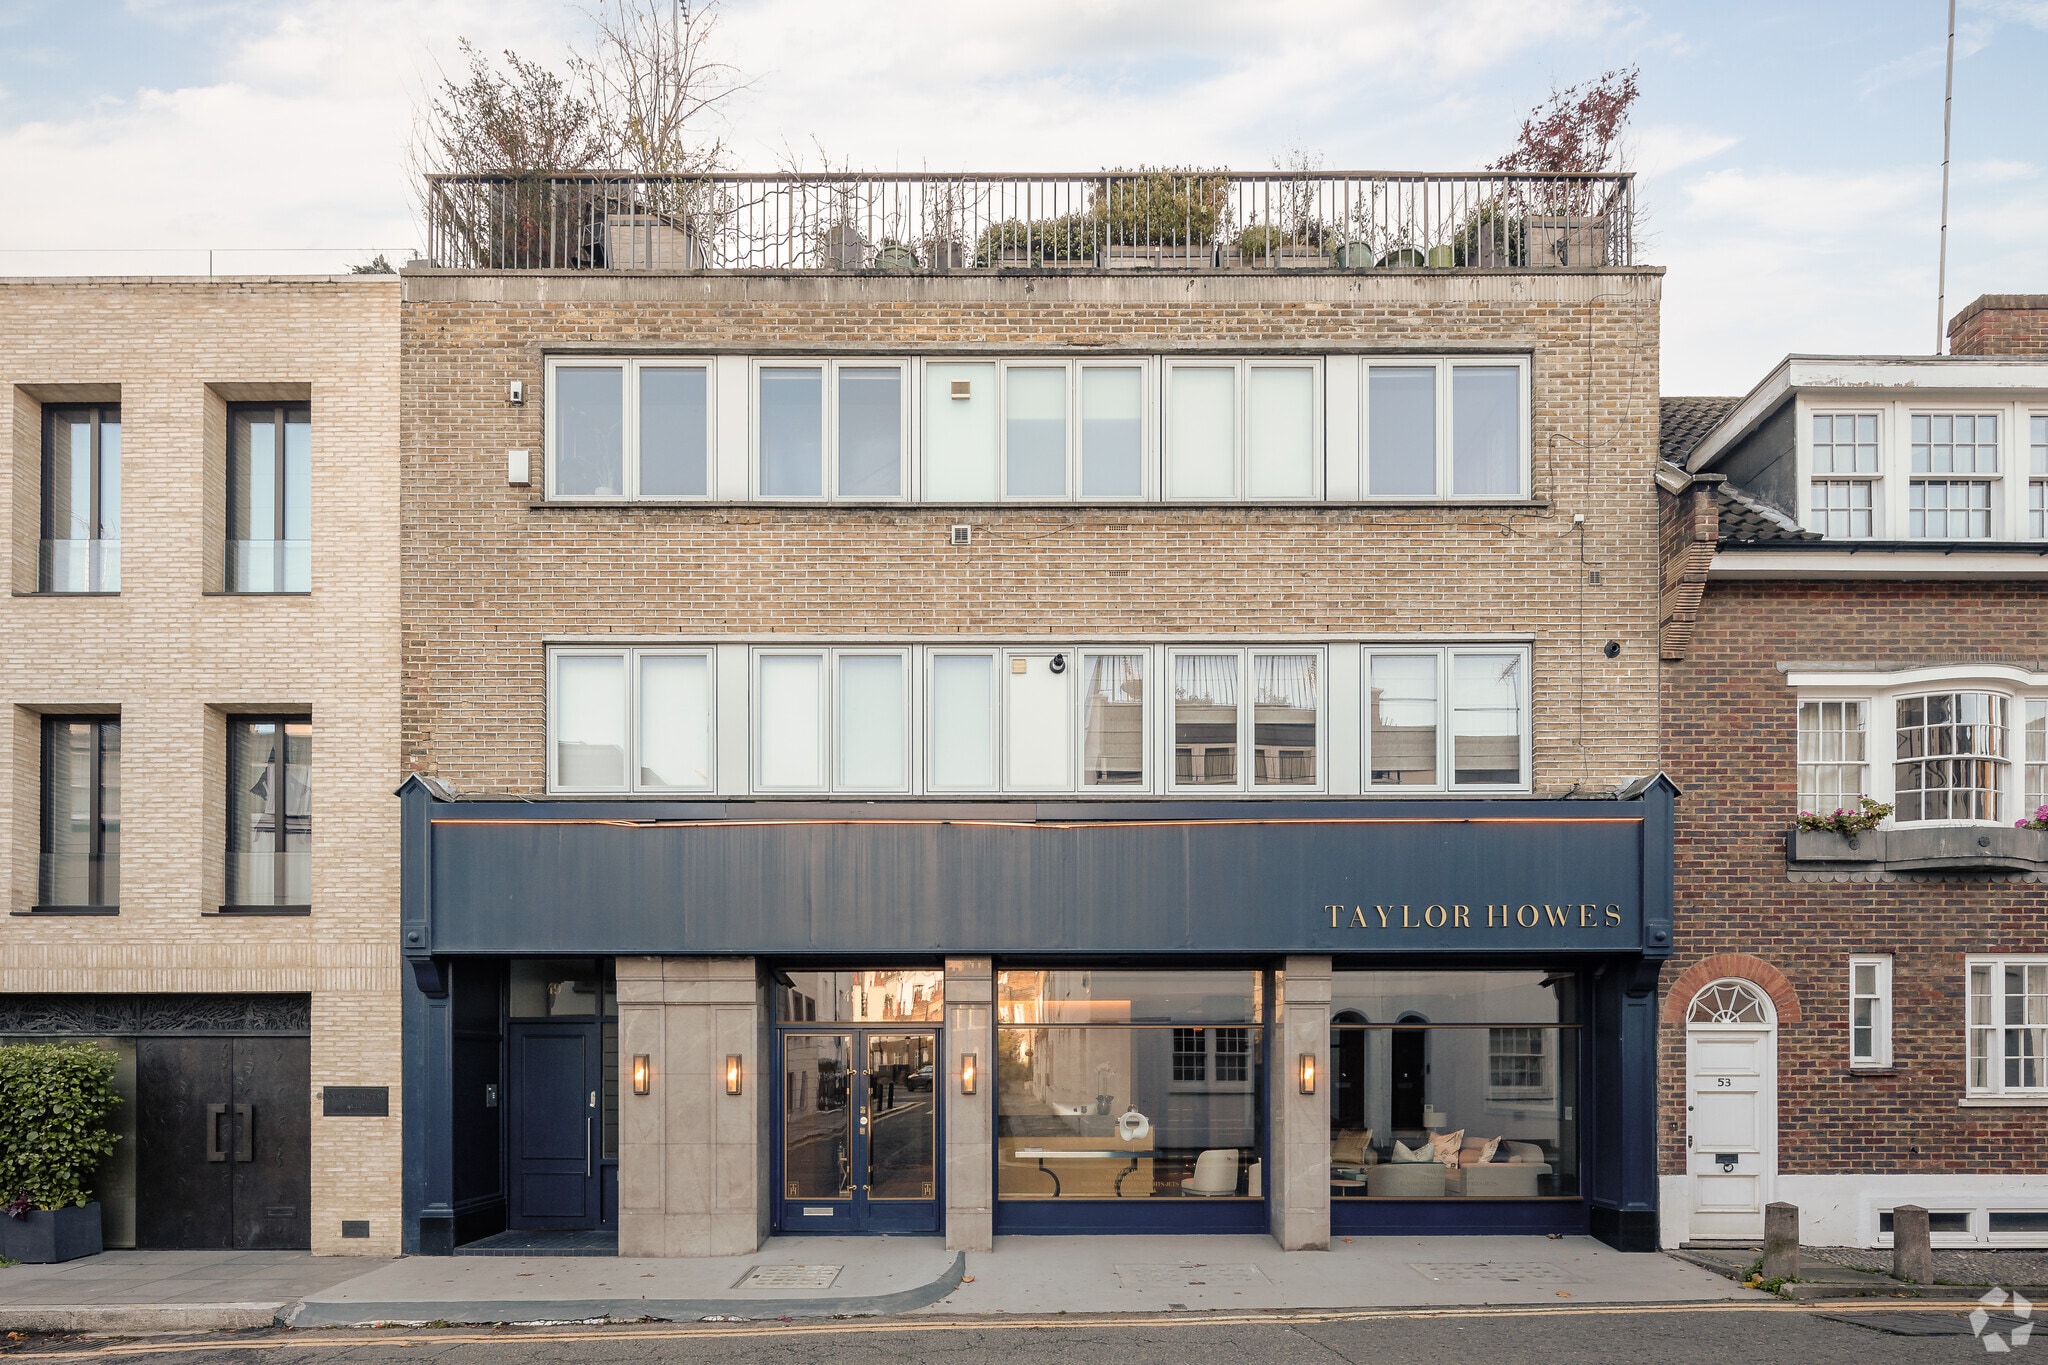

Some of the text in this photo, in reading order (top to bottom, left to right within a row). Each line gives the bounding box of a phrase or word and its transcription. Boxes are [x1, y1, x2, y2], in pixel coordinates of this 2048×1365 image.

[1324, 904, 1623, 928] TAYLOR HOWES
[1717, 1077, 1732, 1087] 53
